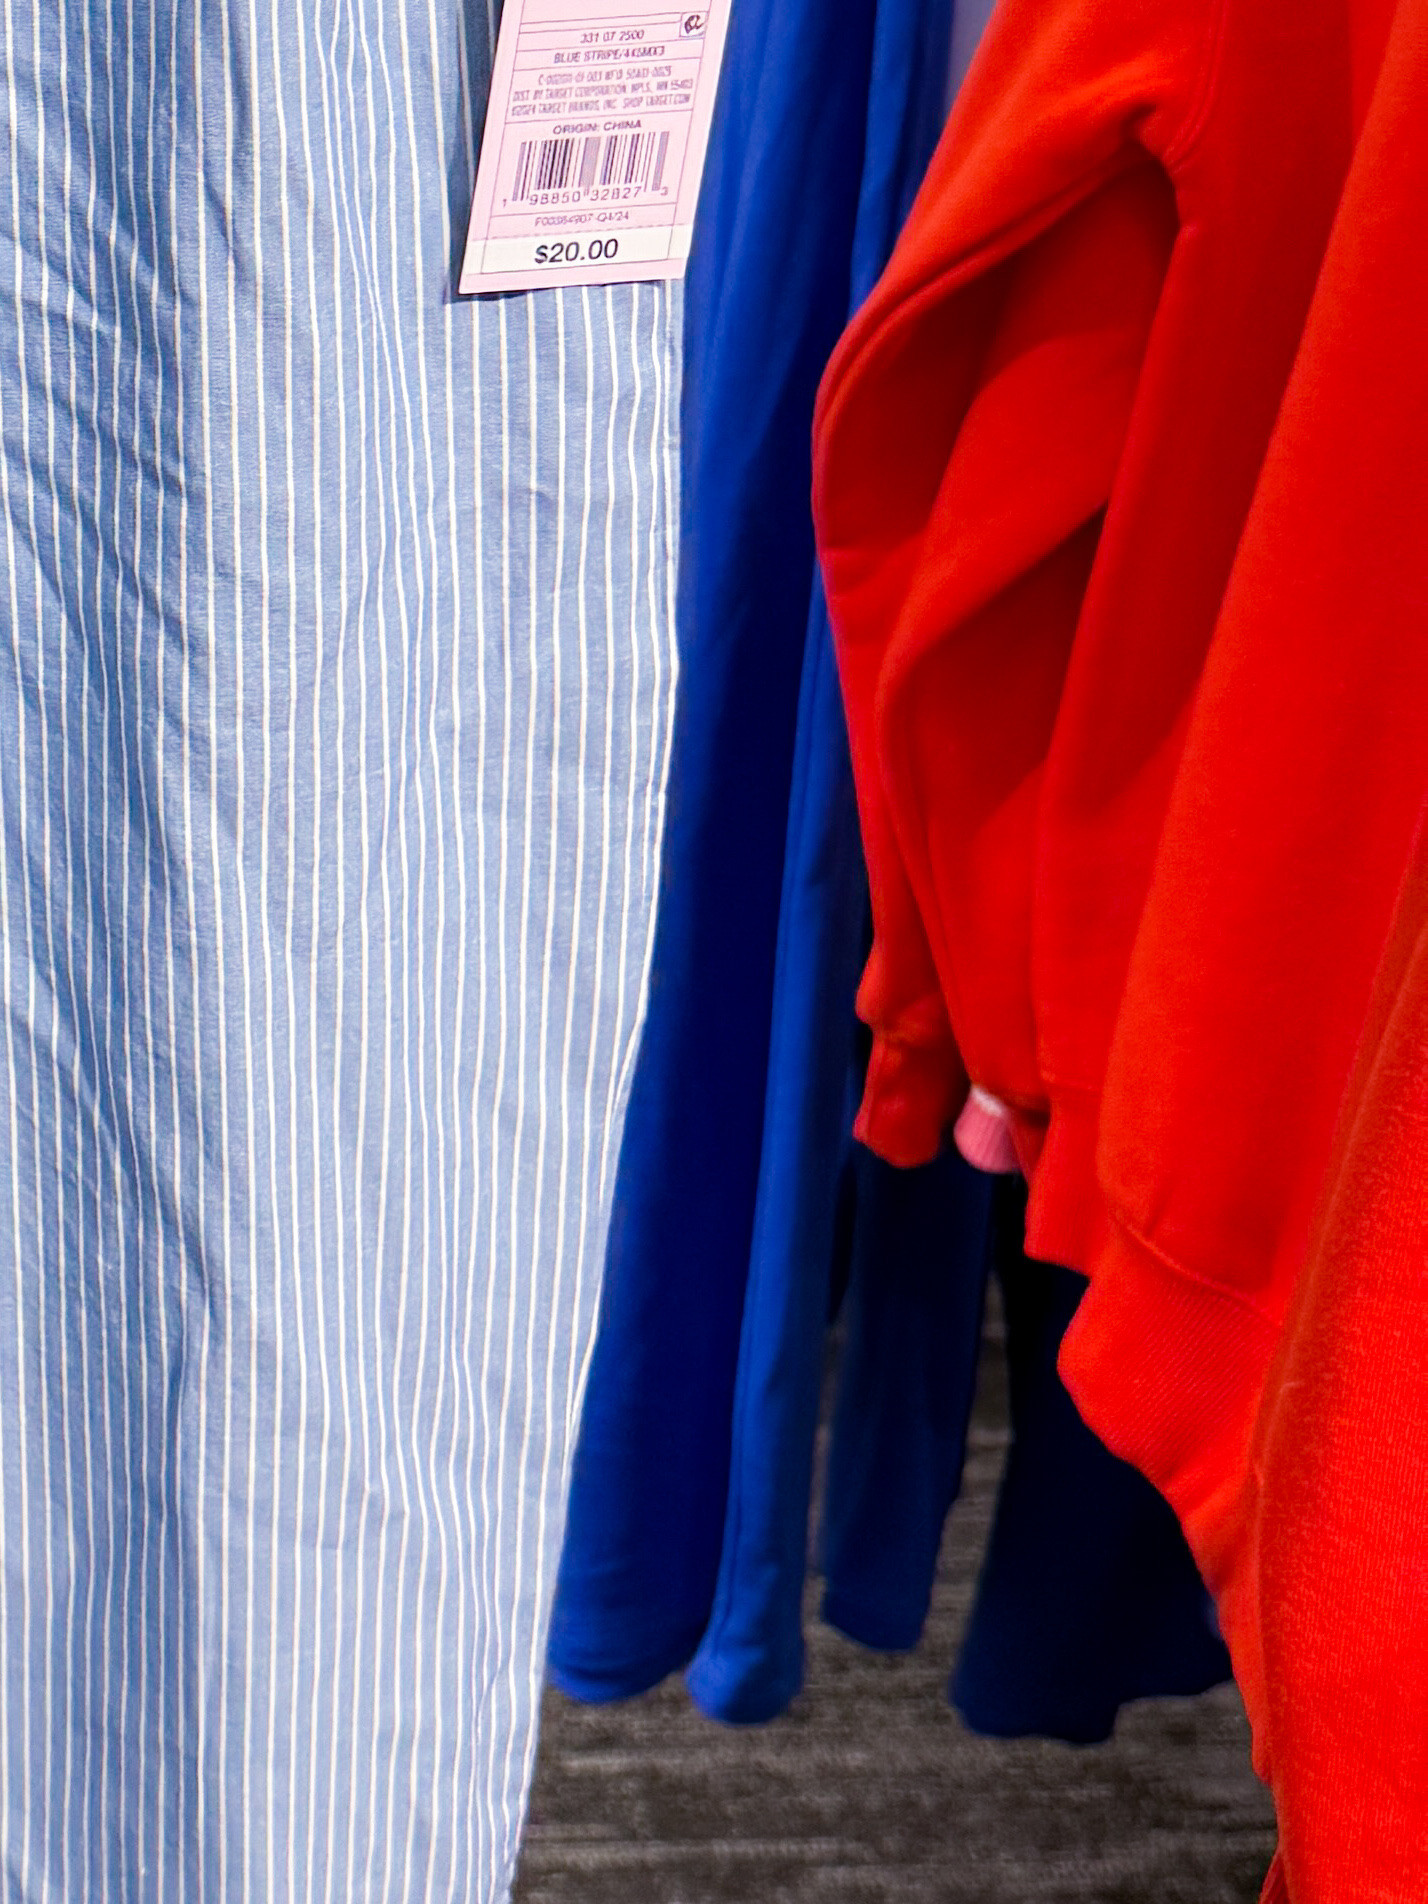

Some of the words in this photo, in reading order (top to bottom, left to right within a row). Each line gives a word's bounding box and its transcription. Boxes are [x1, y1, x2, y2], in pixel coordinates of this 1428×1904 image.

[553, 51, 580, 63] BLUE
[552, 122, 598, 134] ORIGIN:
[603, 119, 642, 130] CHINA
[528, 190, 582, 205] 98850
[660, 186, 668, 195] 3
[534, 238, 619, 264] $20.00
